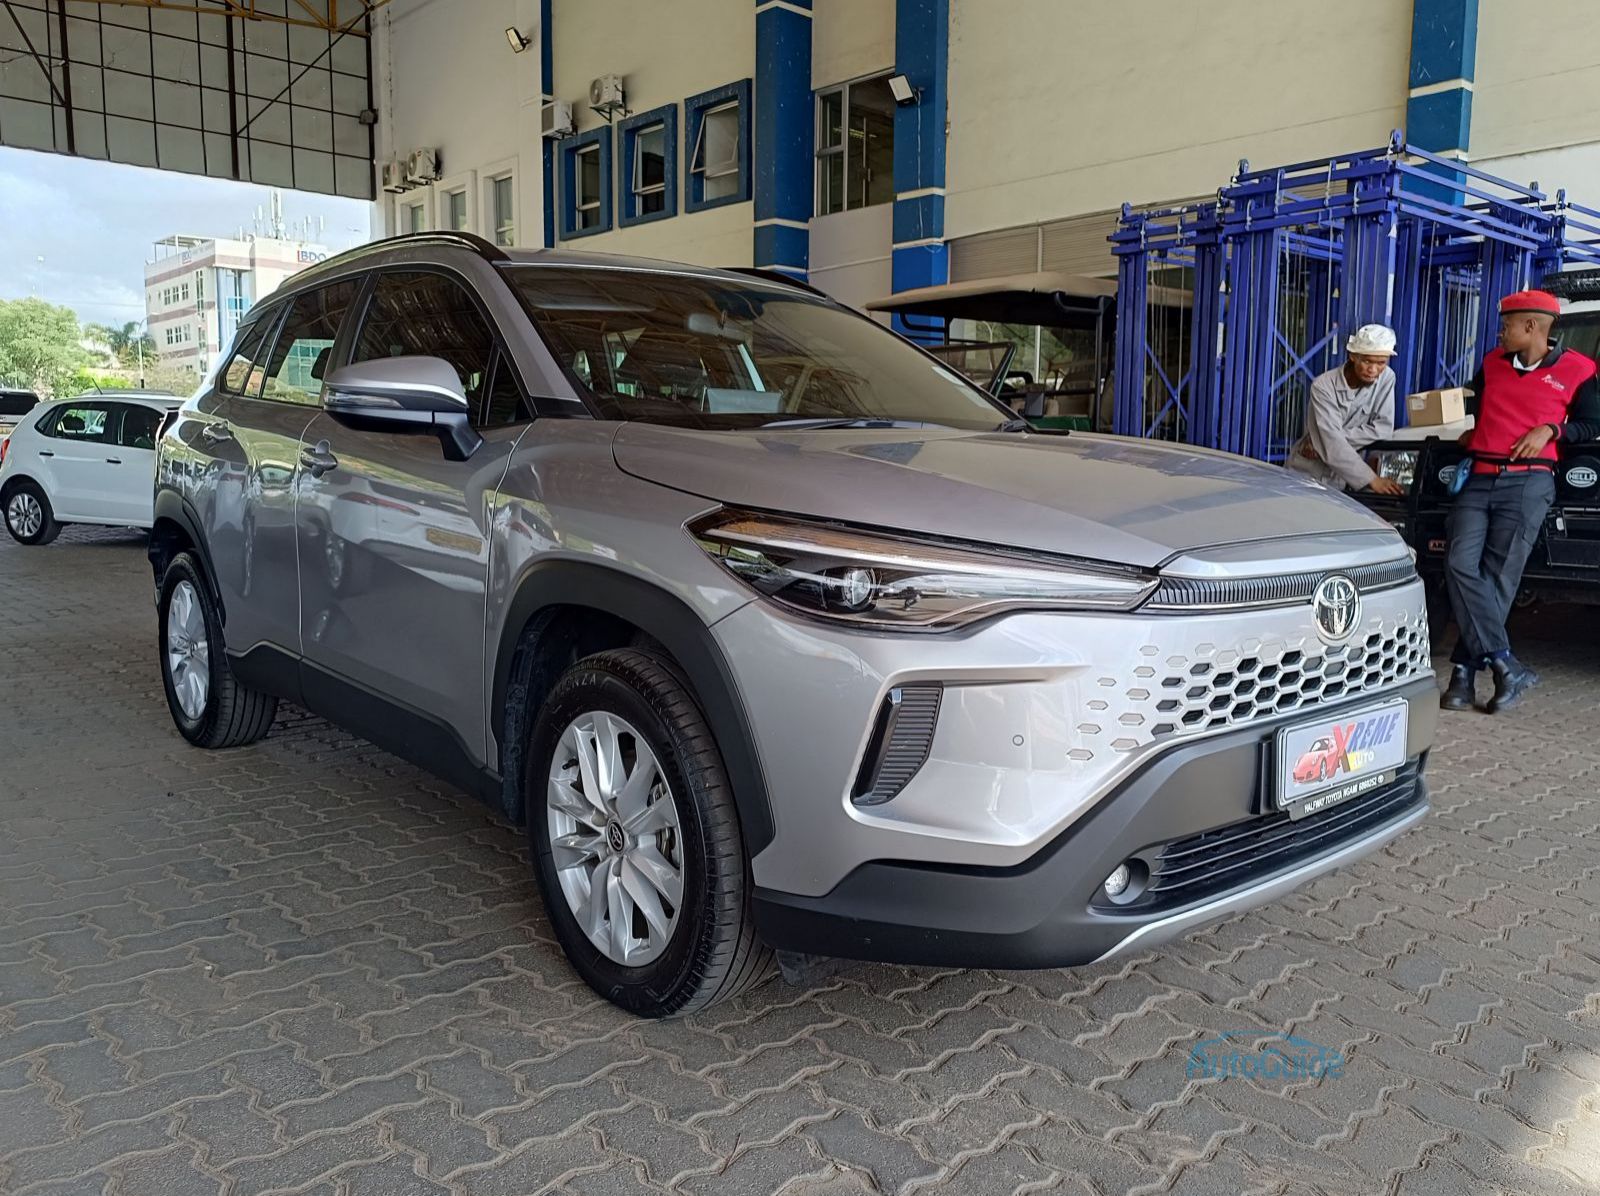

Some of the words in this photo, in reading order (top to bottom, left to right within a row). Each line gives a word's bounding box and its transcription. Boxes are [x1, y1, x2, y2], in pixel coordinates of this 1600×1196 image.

[301, 250, 327, 262] BDO
[1353, 750, 1375, 767] AUTO
[1304, 798, 1325, 813] HALFWAY
[1326, 790, 1342, 804] TOYOTA
